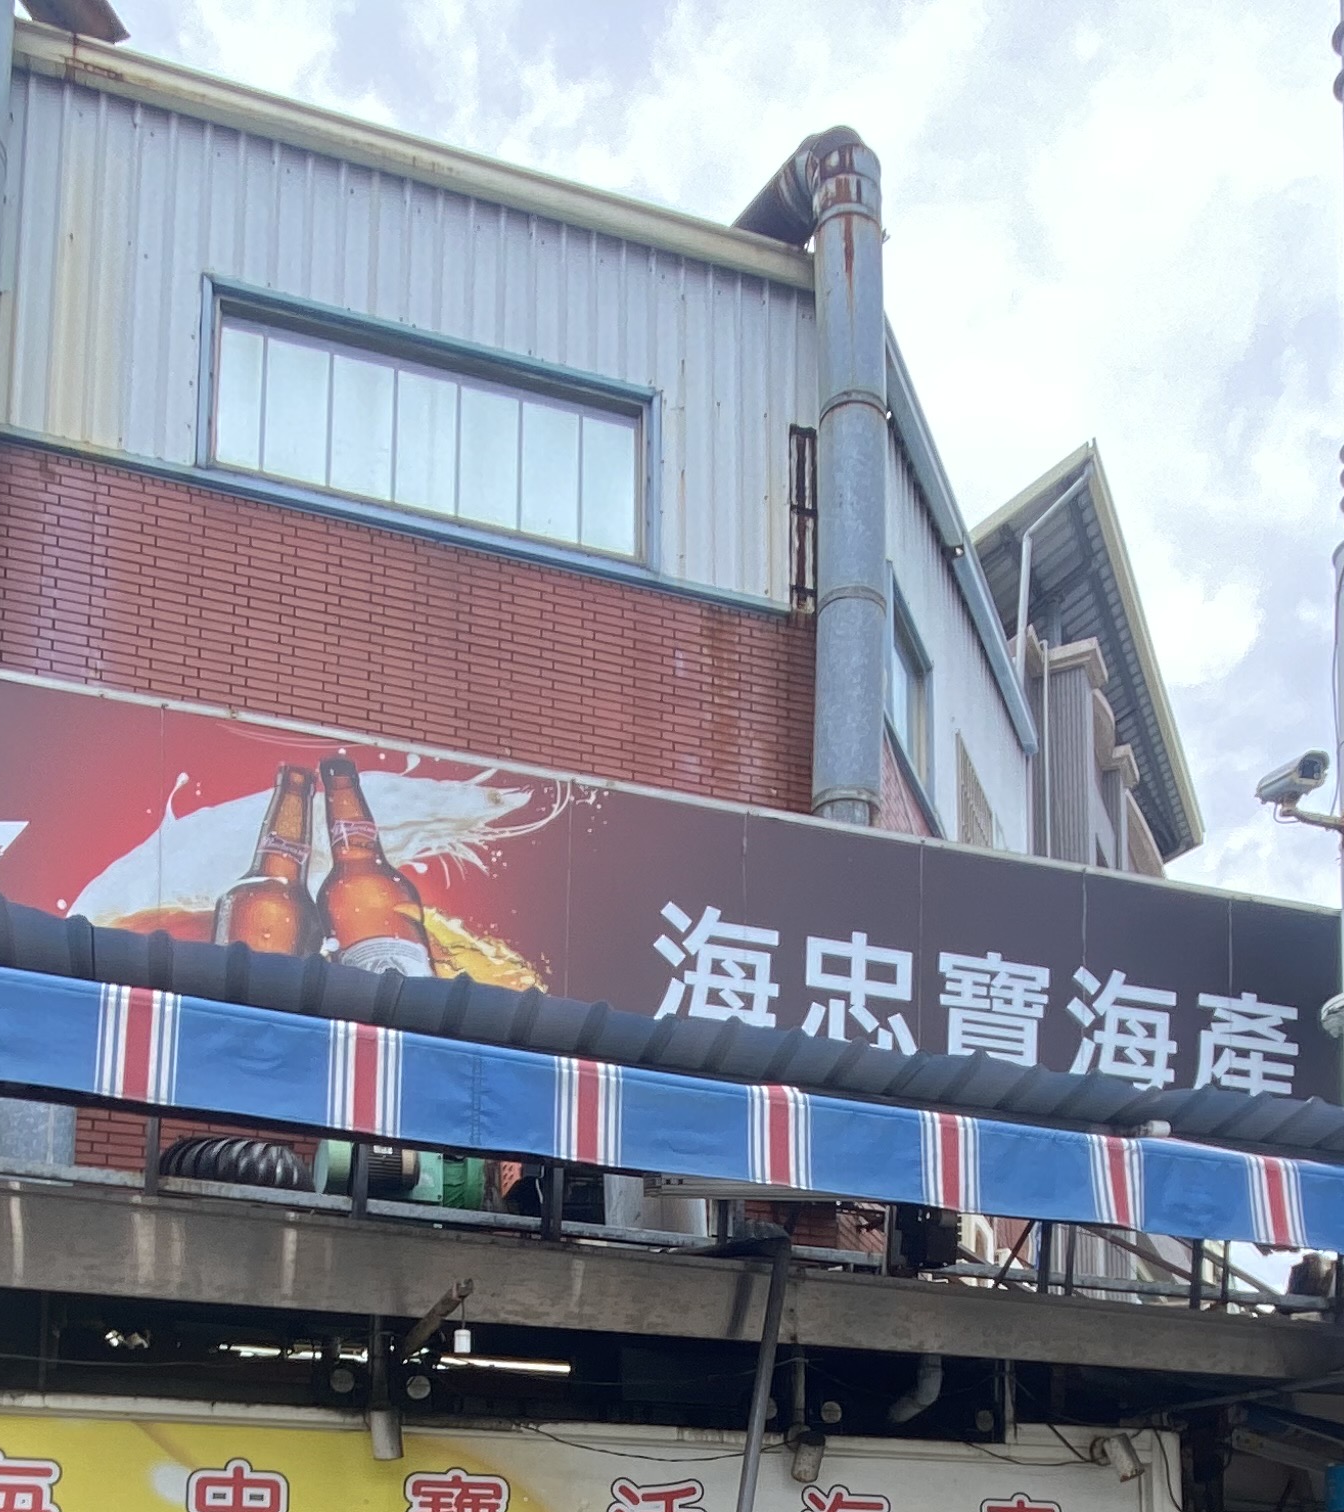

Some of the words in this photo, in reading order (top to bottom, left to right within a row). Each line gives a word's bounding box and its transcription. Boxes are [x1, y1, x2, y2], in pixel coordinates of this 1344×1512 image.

[654, 901, 1300, 1099] 海忠寶海產
